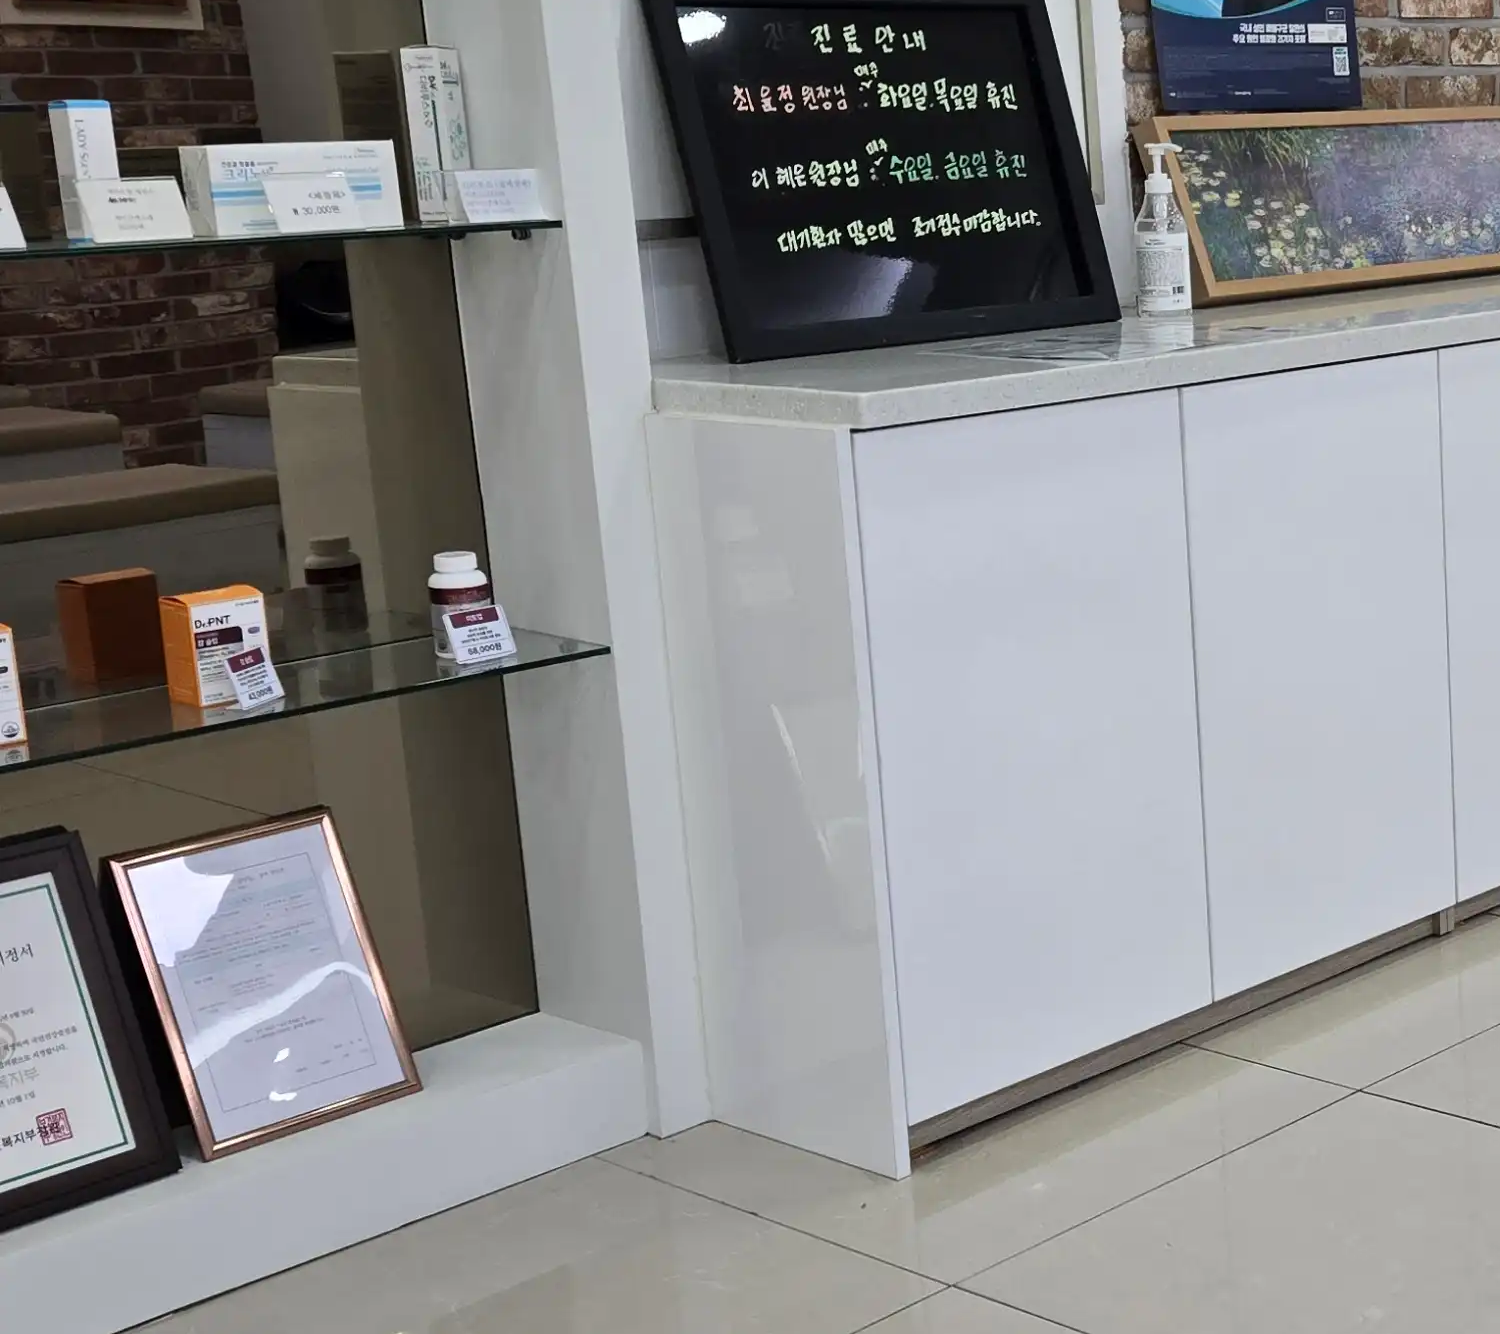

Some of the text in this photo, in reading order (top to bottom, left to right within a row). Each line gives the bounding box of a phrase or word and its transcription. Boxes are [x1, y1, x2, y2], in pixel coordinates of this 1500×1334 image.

[810, 23, 927, 54] 진료 안내
[801, 83, 848, 112] 원장님
[984, 80, 1018, 111] 휴진
[944, 151, 989, 181] 금요일
[995, 149, 1028, 180] 휴진
[777, 224, 842, 253] 대기환자
[846, 217, 897, 247] 많으면
[194, 614, 231, 629] Dr.PNT
